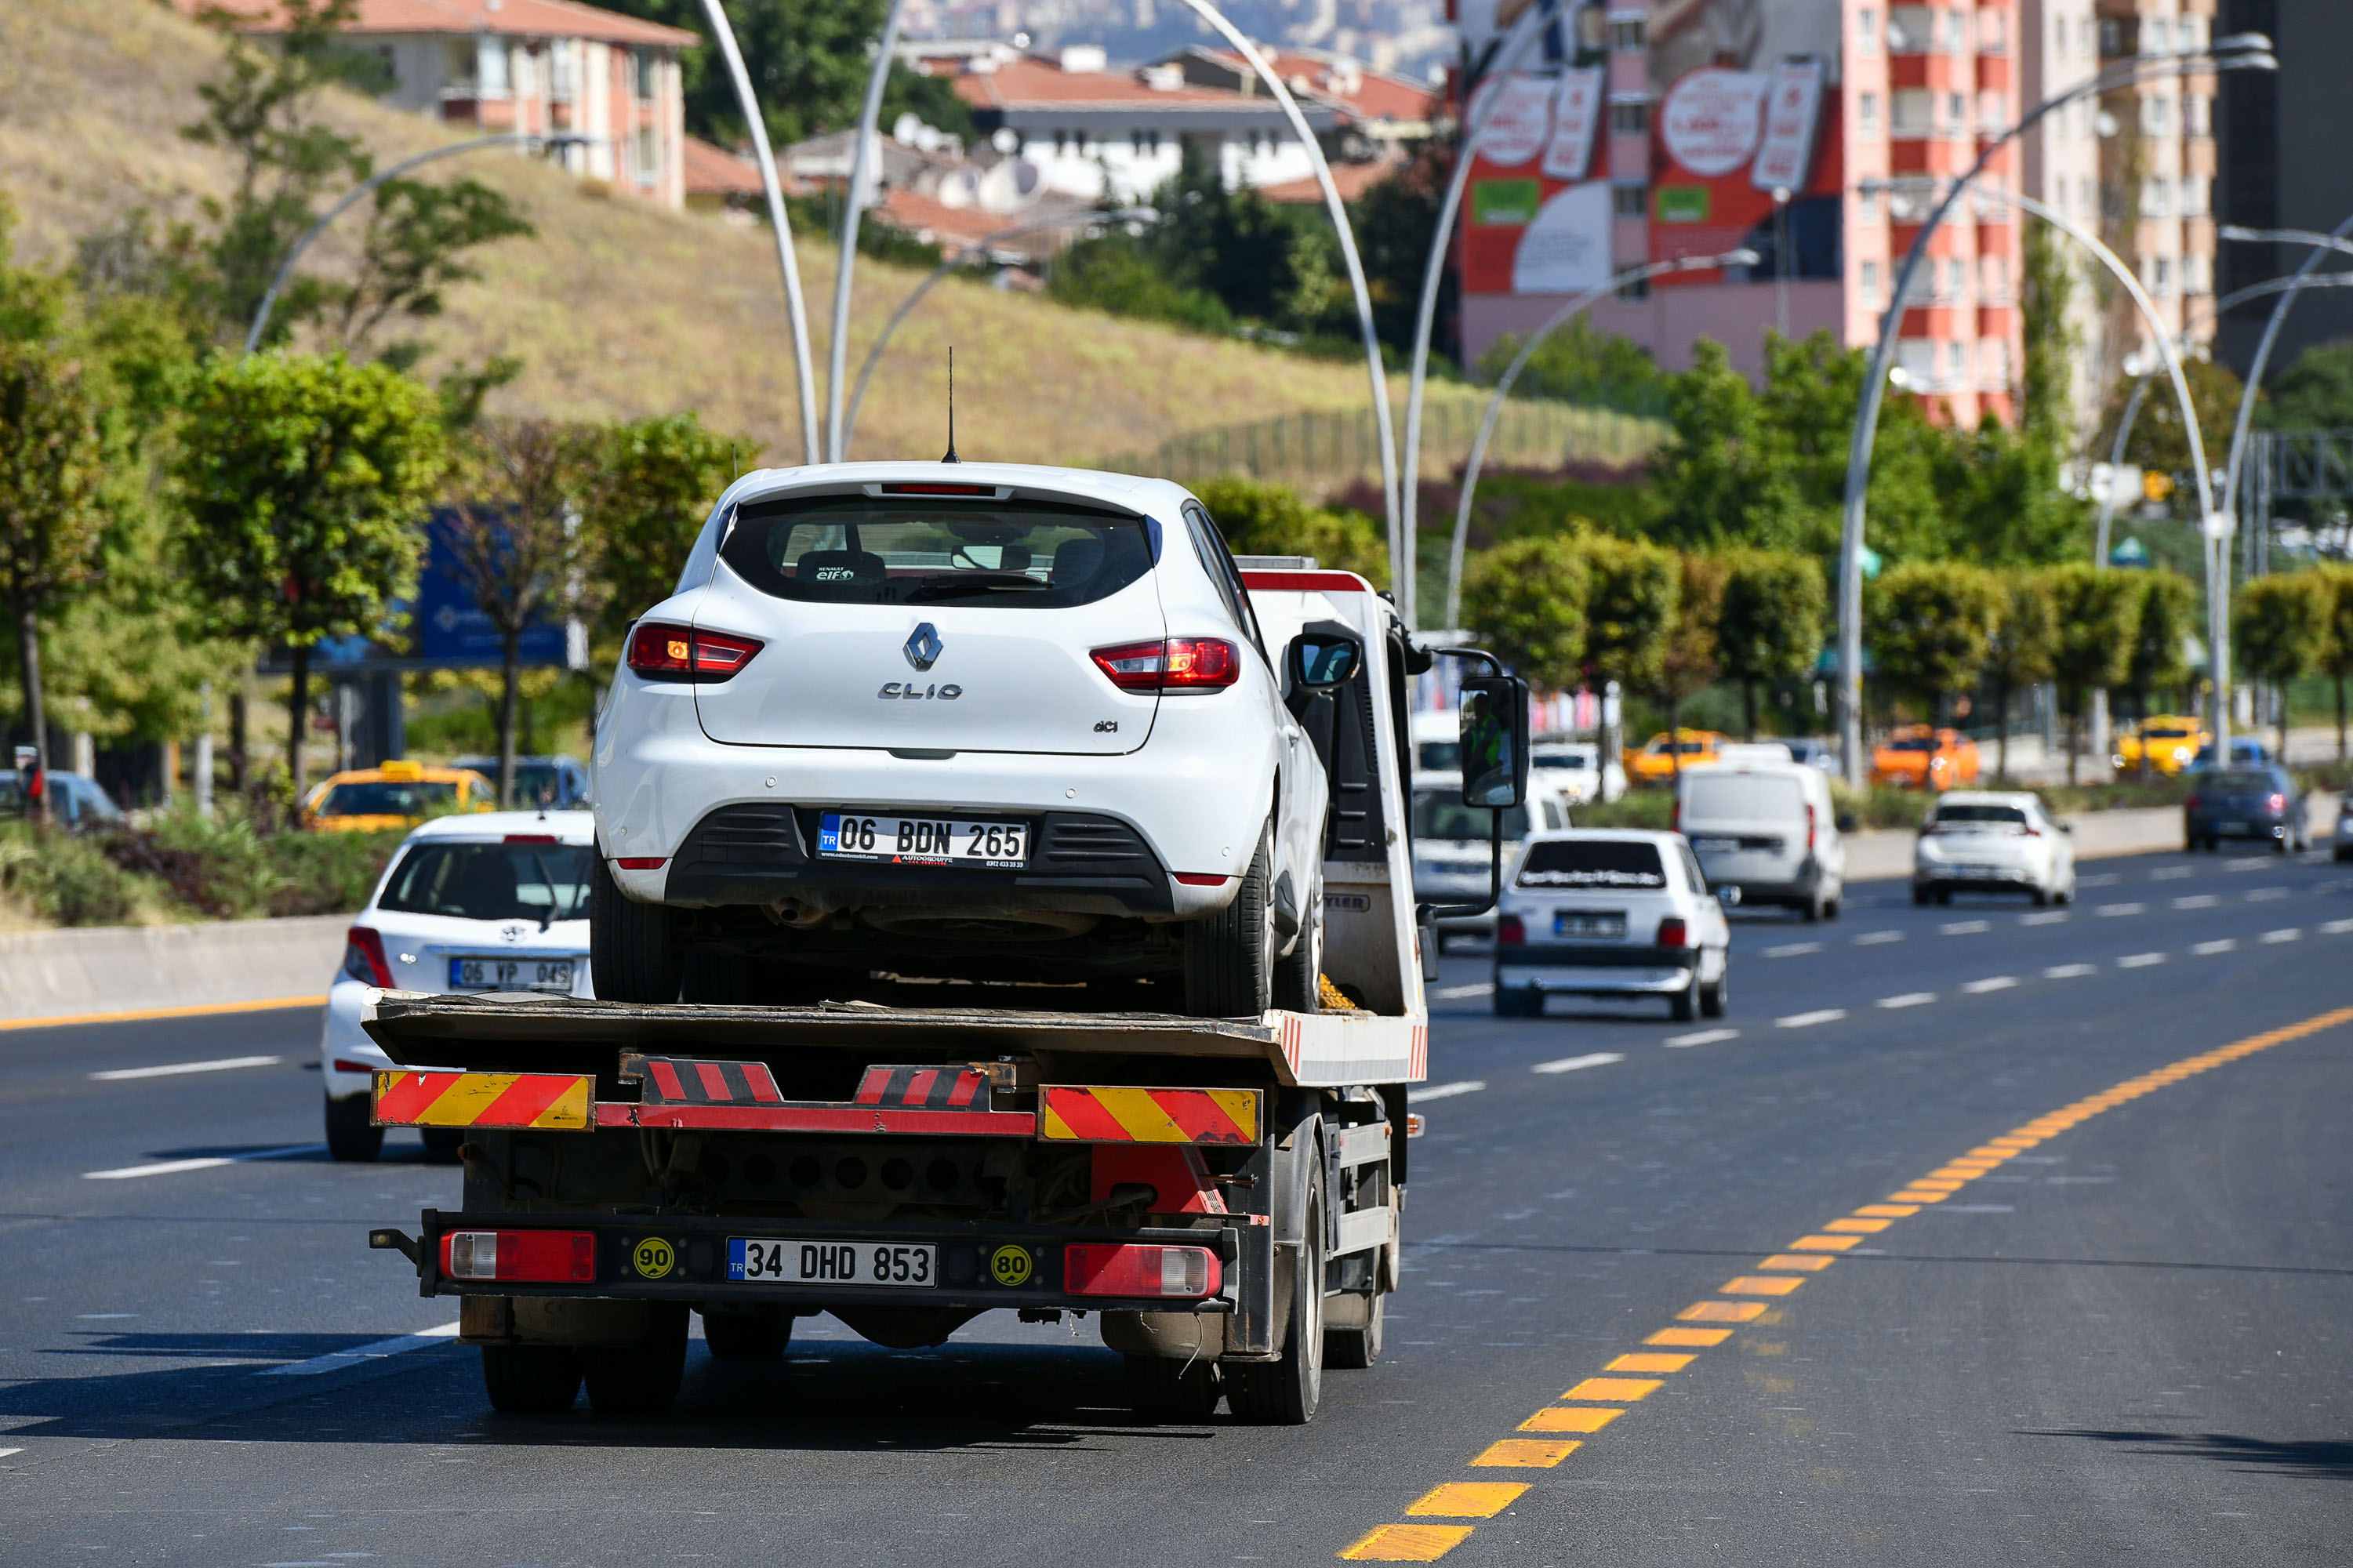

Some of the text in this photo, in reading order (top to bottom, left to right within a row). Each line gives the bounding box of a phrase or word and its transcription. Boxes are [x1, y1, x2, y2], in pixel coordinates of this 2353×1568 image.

[816, 571, 841, 580] elf
[877, 682, 963, 700] CLIO
[823, 835, 836, 845] TR
[841, 818, 1021, 857] 06 BDN 265
[463, 962, 484, 982] 06
[640, 1248, 669, 1266] 90
[746, 1243, 929, 1283] 34 DHD 853
[997, 1256, 1026, 1274] 80
[731, 1262, 743, 1272] TR
